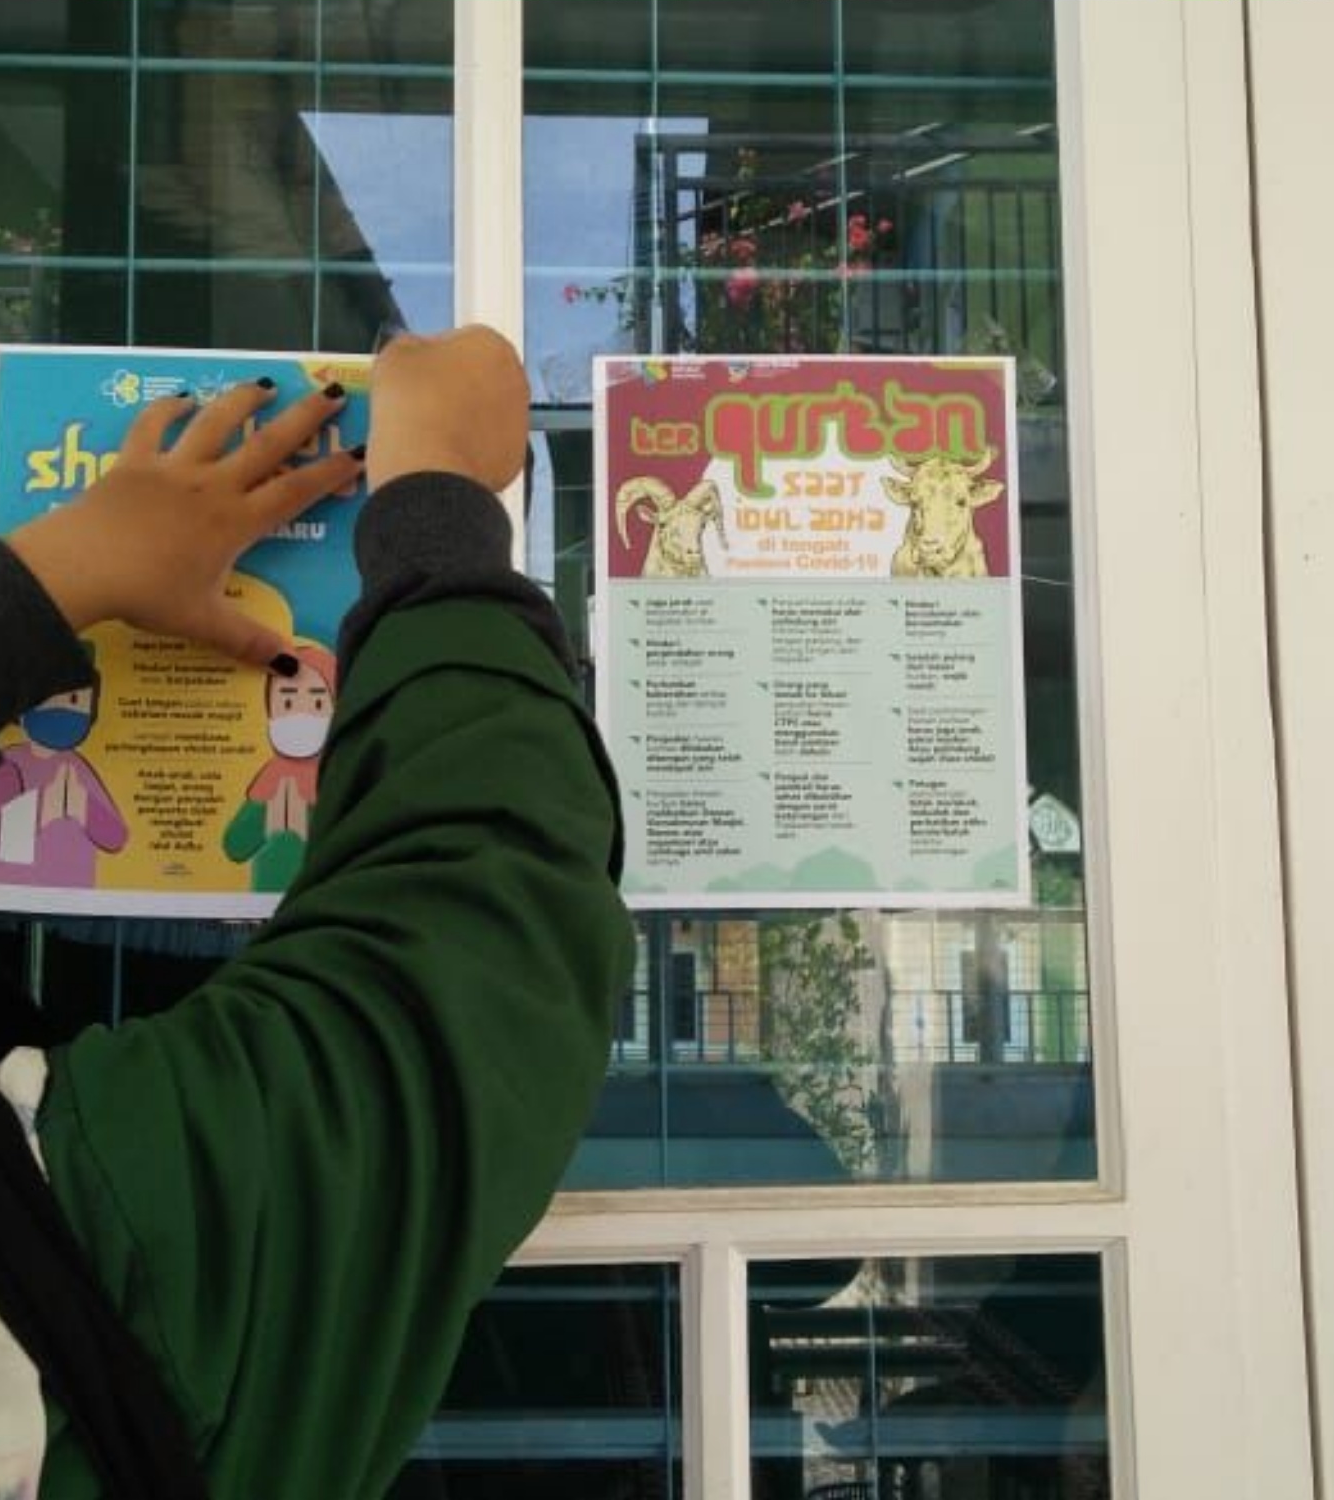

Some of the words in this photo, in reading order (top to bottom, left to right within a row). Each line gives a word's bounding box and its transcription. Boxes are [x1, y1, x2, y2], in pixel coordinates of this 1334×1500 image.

[270, 522, 327, 540] ARU
[757, 537, 776, 552] di
[781, 537, 850, 555] tengah
